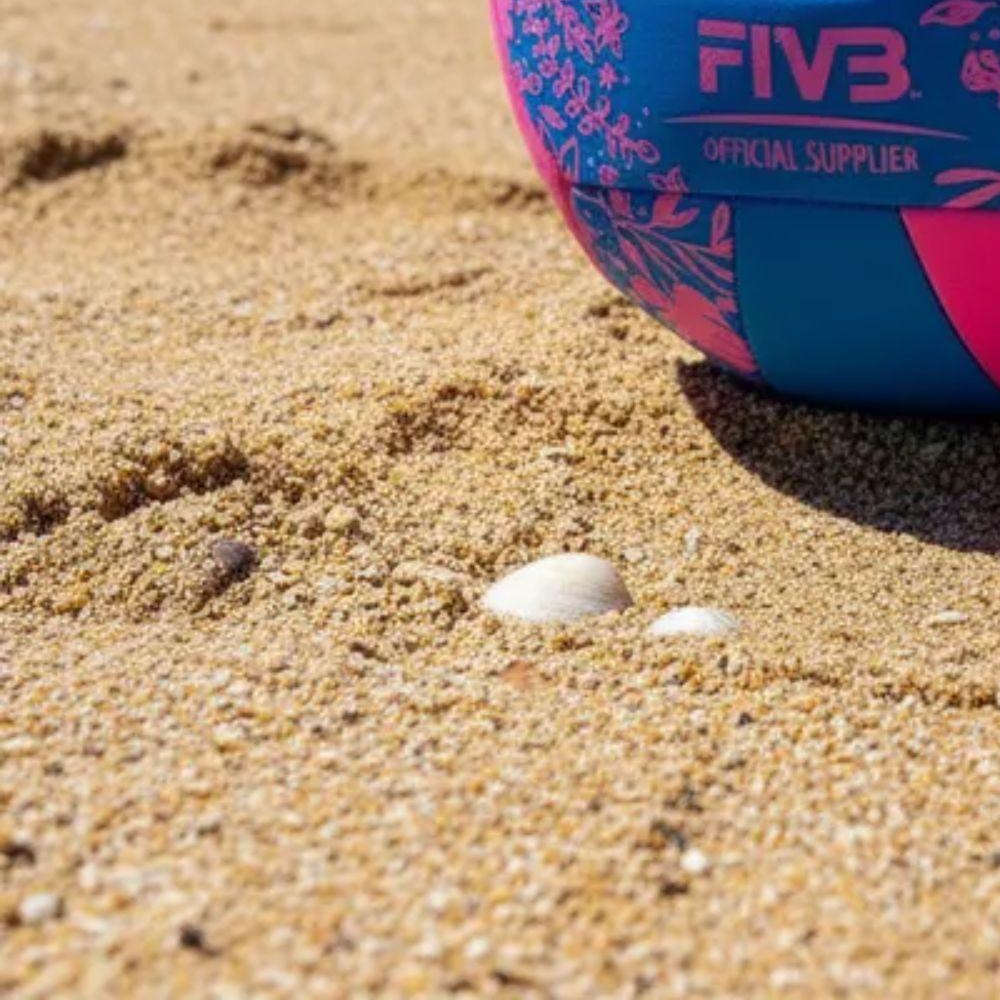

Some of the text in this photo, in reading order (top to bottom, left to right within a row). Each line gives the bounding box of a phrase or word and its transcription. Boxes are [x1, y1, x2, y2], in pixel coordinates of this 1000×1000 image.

[699, 18, 911, 102] FIVB
[704, 135, 918, 175] OFFICIAL SUPPLIER
